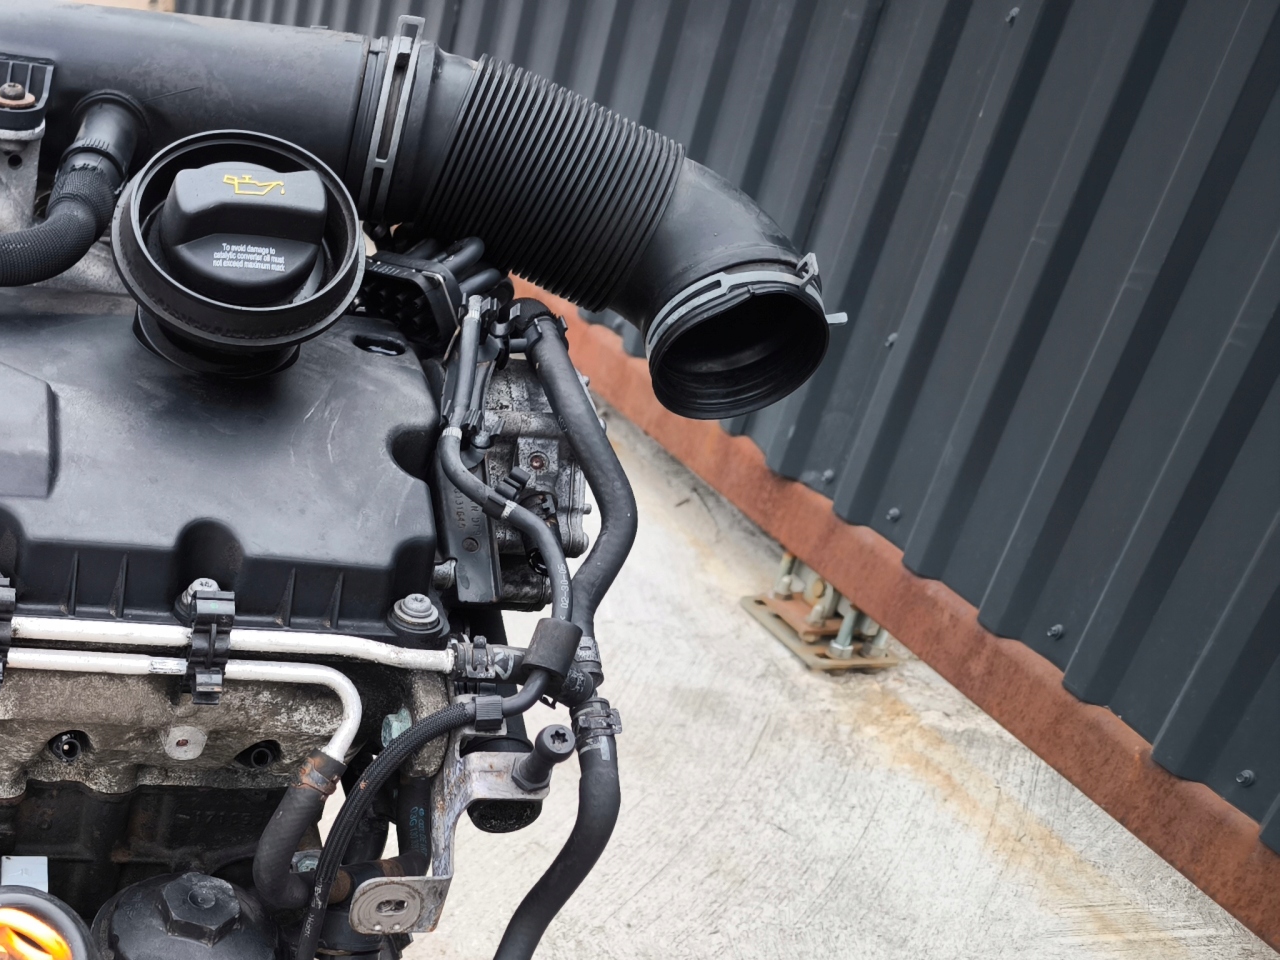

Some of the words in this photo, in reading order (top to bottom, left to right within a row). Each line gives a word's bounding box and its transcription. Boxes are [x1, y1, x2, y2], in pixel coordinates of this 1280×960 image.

[222, 243, 230, 251] To
[231, 244, 246, 252] avoid
[247, 245, 269, 255] damage
[270, 247, 276, 255] to
[213, 251, 236, 260] catalytic
[237, 252, 263, 261] converter
[271, 256, 285, 264] must
[213, 259, 222, 267] not
[223, 260, 243, 269] exceed
[244, 261, 270, 270] maximum
[271, 263, 286, 272] mark
[558, 563, 570, 609] 02-30-05
